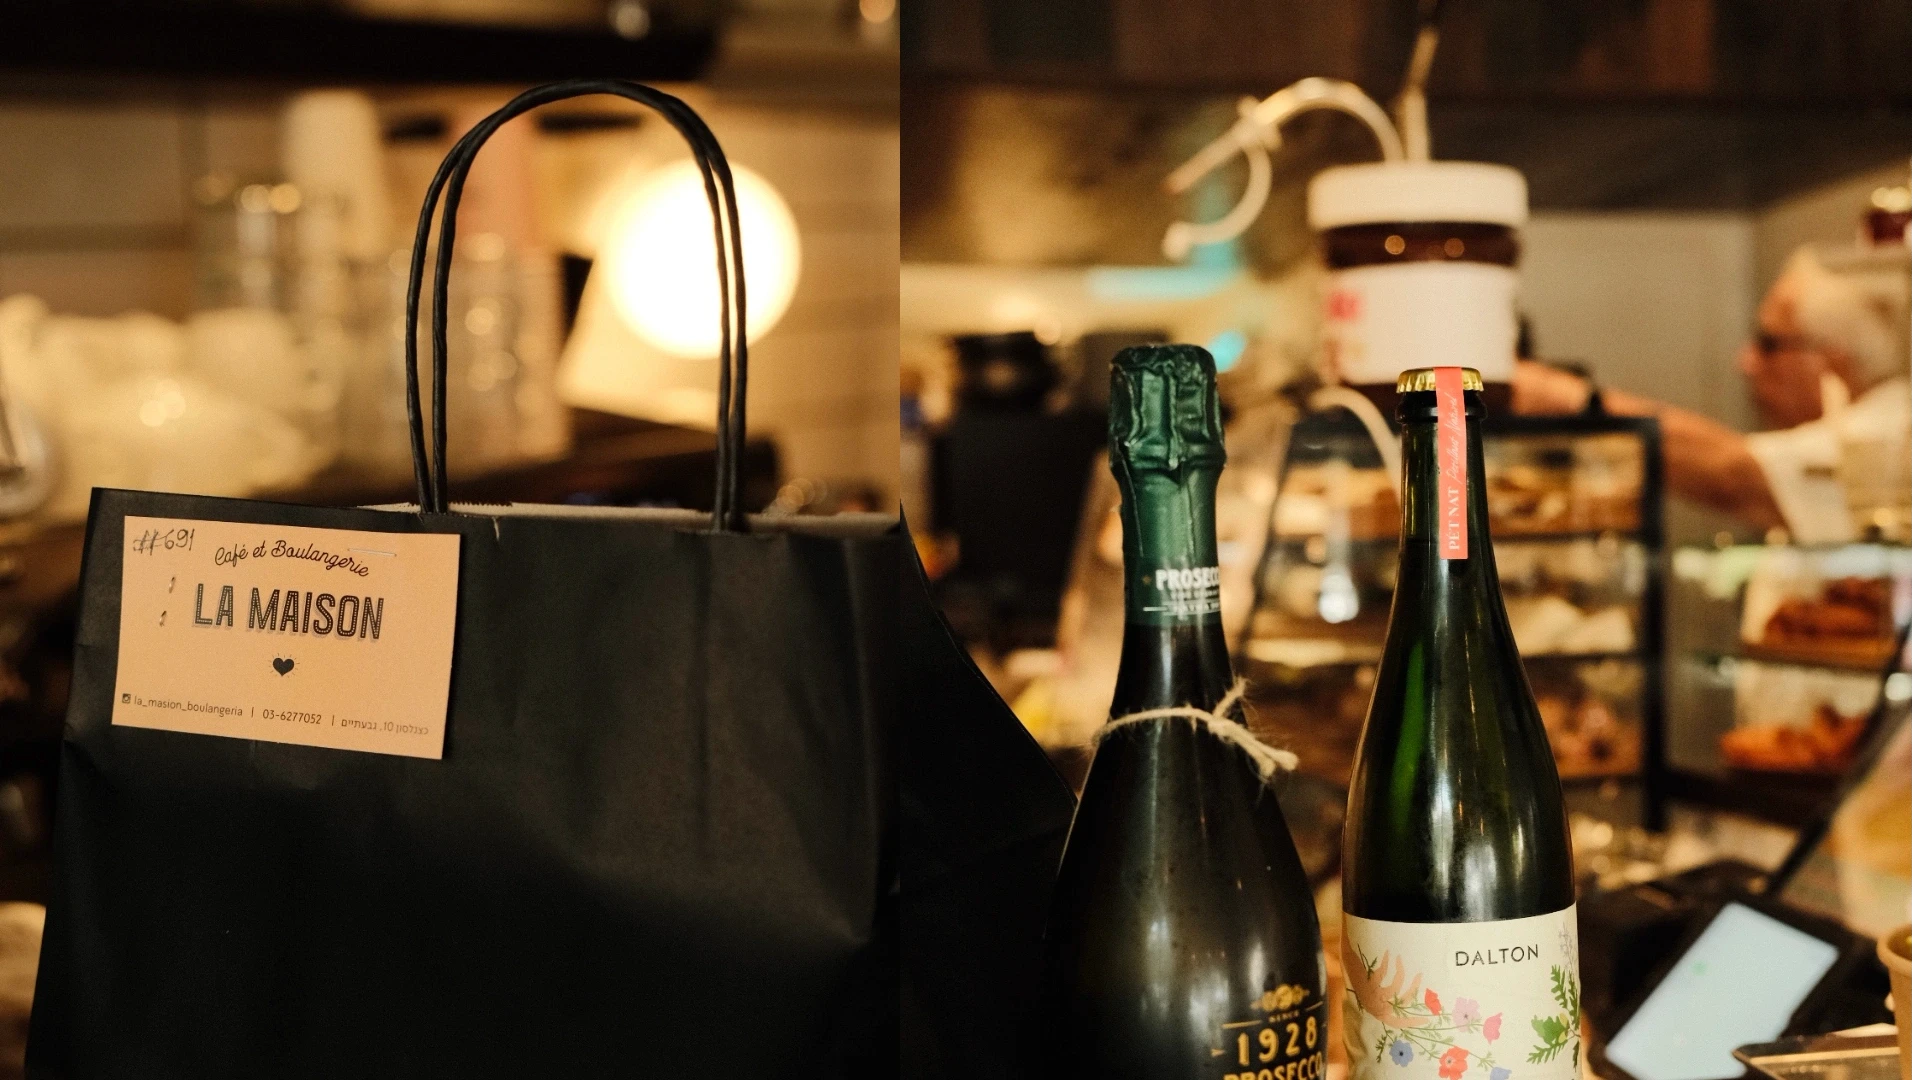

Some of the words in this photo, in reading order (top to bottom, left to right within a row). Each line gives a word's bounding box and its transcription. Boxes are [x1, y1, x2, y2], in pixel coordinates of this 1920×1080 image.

[1448, 487, 1459, 518] NAT
[1446, 521, 1460, 551] PÉT
[214, 544, 249, 567] Café
[252, 540, 267, 559] et
[271, 539, 370, 578] Boulangerie
[193, 583, 234, 627] LA
[248, 587, 385, 641] MAISON
[134, 695, 243, 718] la_masion_boulangeria
[262, 708, 323, 725] 03-6277052
[1455, 944, 1540, 967] DALTON
[1238, 1016, 1318, 1067] 1928
[1223, 1051, 1324, 1080] SECCO
